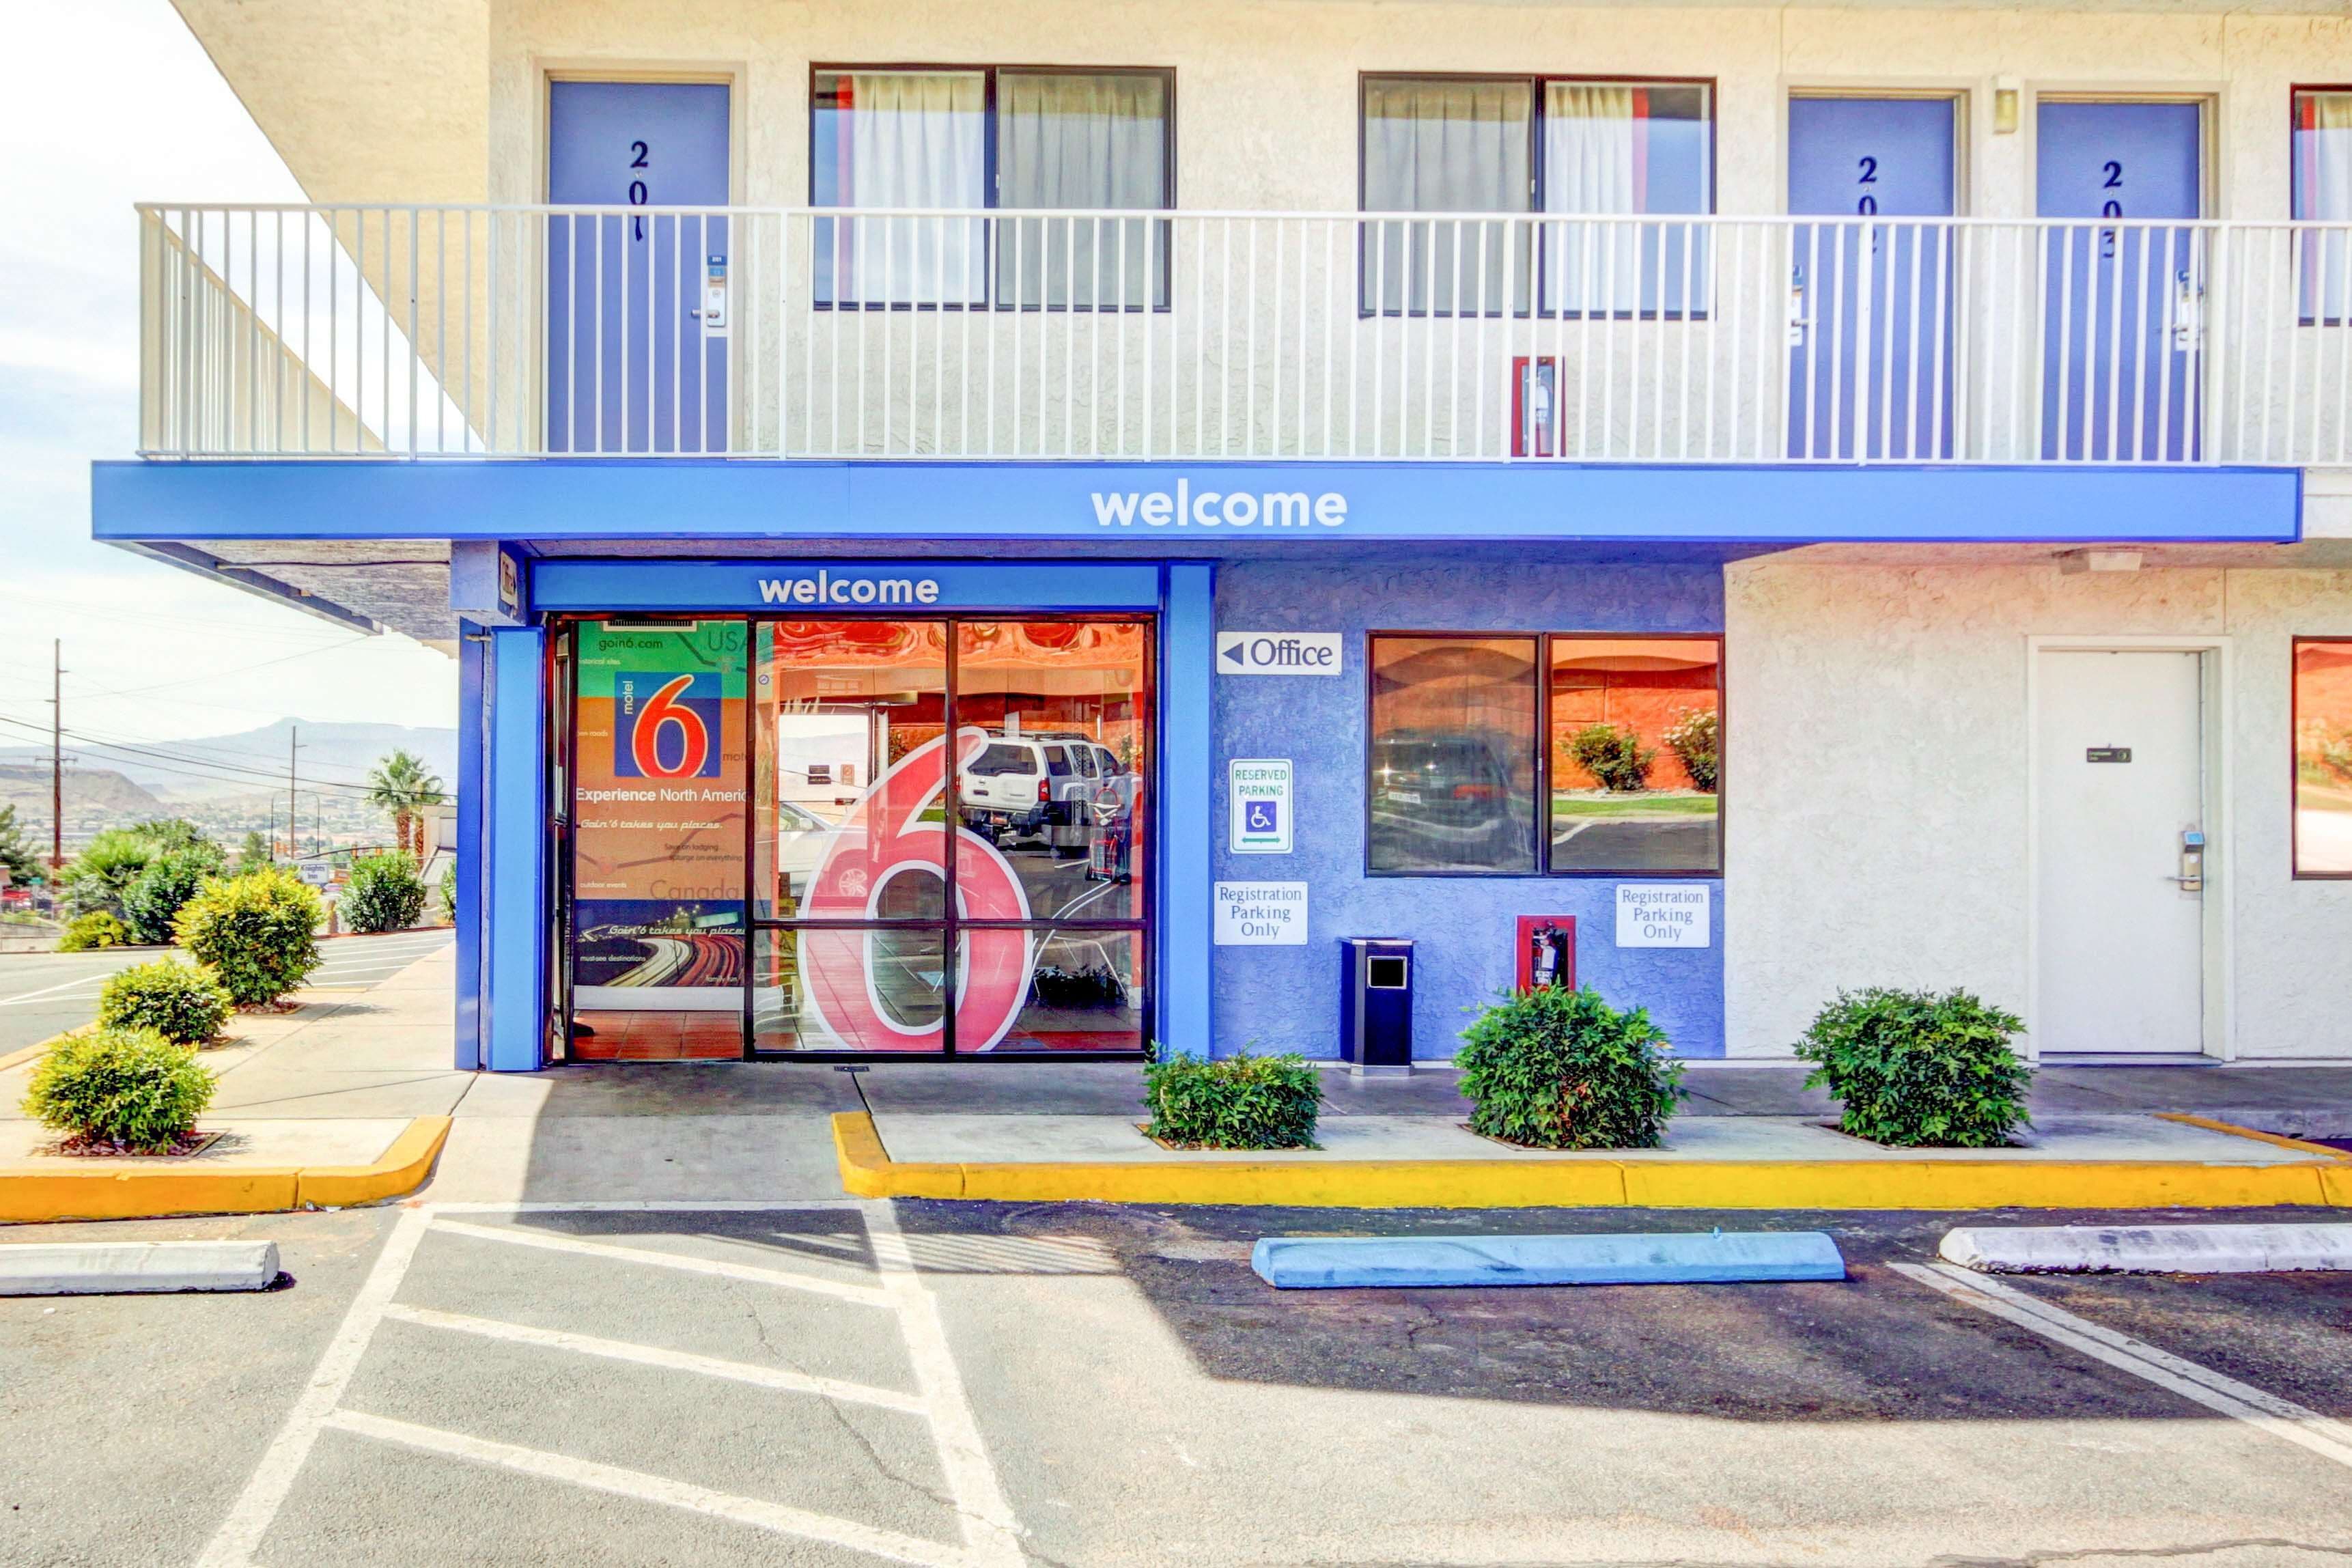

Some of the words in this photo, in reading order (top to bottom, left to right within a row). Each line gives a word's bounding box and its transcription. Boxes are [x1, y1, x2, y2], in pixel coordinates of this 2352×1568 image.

[1858, 156, 1878, 254] 20
[1091, 478, 1347, 527] welcome
[758, 570, 939, 603] welcome
[1250, 639, 1333, 666] Office
[623, 681, 633, 715] motel
[632, 674, 708, 777] 6
[1235, 770, 1287, 781] RESERVED
[576, 788, 656, 803] Experience
[660, 789, 697, 802] North
[701, 788, 747, 802] Americ
[1239, 785, 1284, 796] PARKING
[621, 820, 653, 829] takes
[657, 822, 679, 832] you
[580, 880, 604, 888] outdoor
[650, 878, 739, 899] Canada
[797, 726, 1033, 1052] 6
[1219, 887, 1302, 904] Registration
[1623, 889, 1704, 905] Registration
[1231, 906, 1291, 923] Parking
[1634, 908, 1694, 924] Parking
[649, 925, 682, 934] takes
[686, 927, 706, 938] you
[1241, 923, 1280, 938] Only
[1643, 925, 1682, 941] Only
[608, 954, 647, 962] destinations
